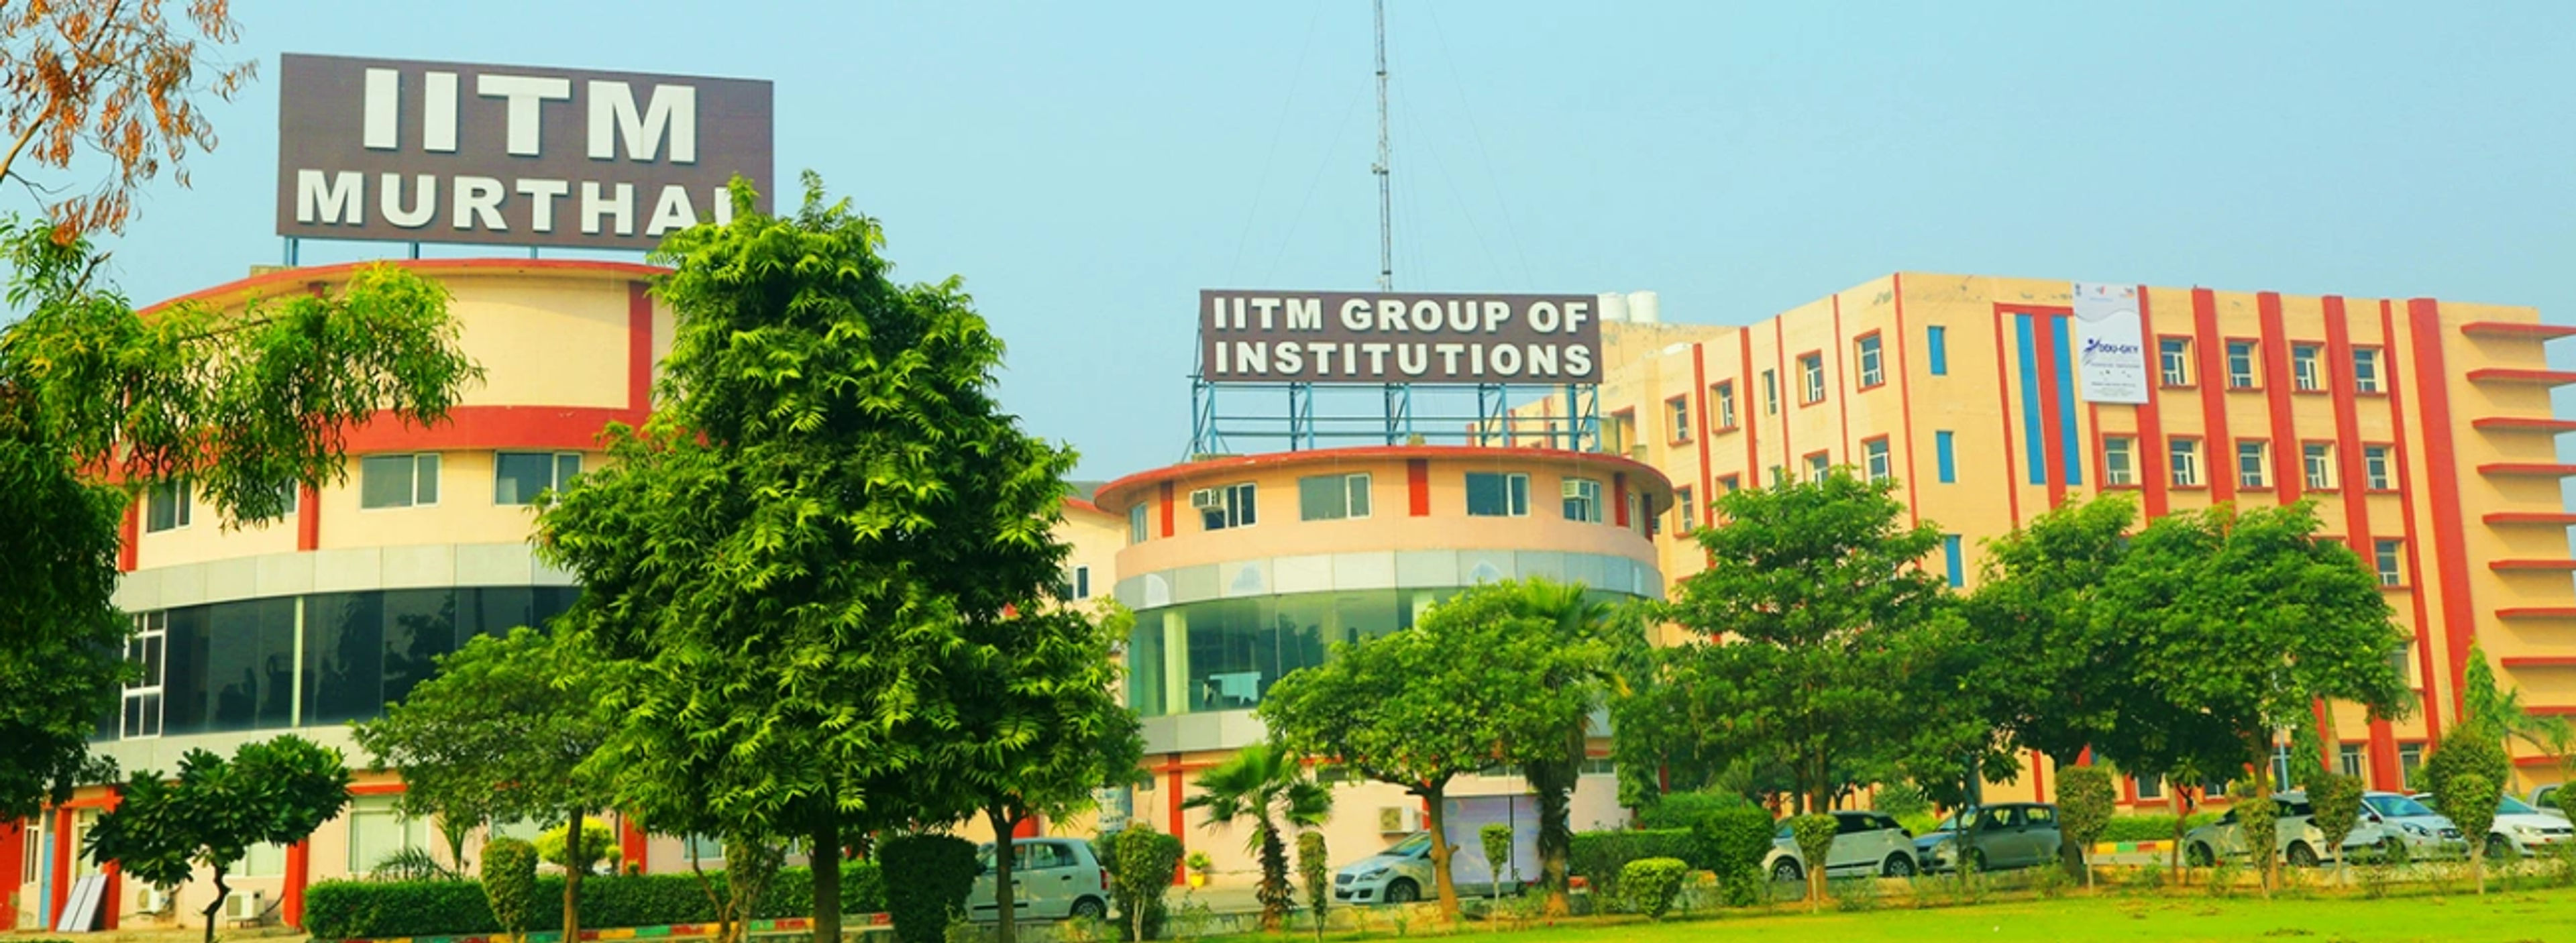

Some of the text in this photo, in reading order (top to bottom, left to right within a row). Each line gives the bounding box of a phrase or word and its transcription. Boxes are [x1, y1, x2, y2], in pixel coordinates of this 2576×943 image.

[364, 68, 697, 163] IITM
[1213, 297, 1589, 333] IITM GROUP OF
[1214, 341, 1593, 376] INSTITUTIONS
